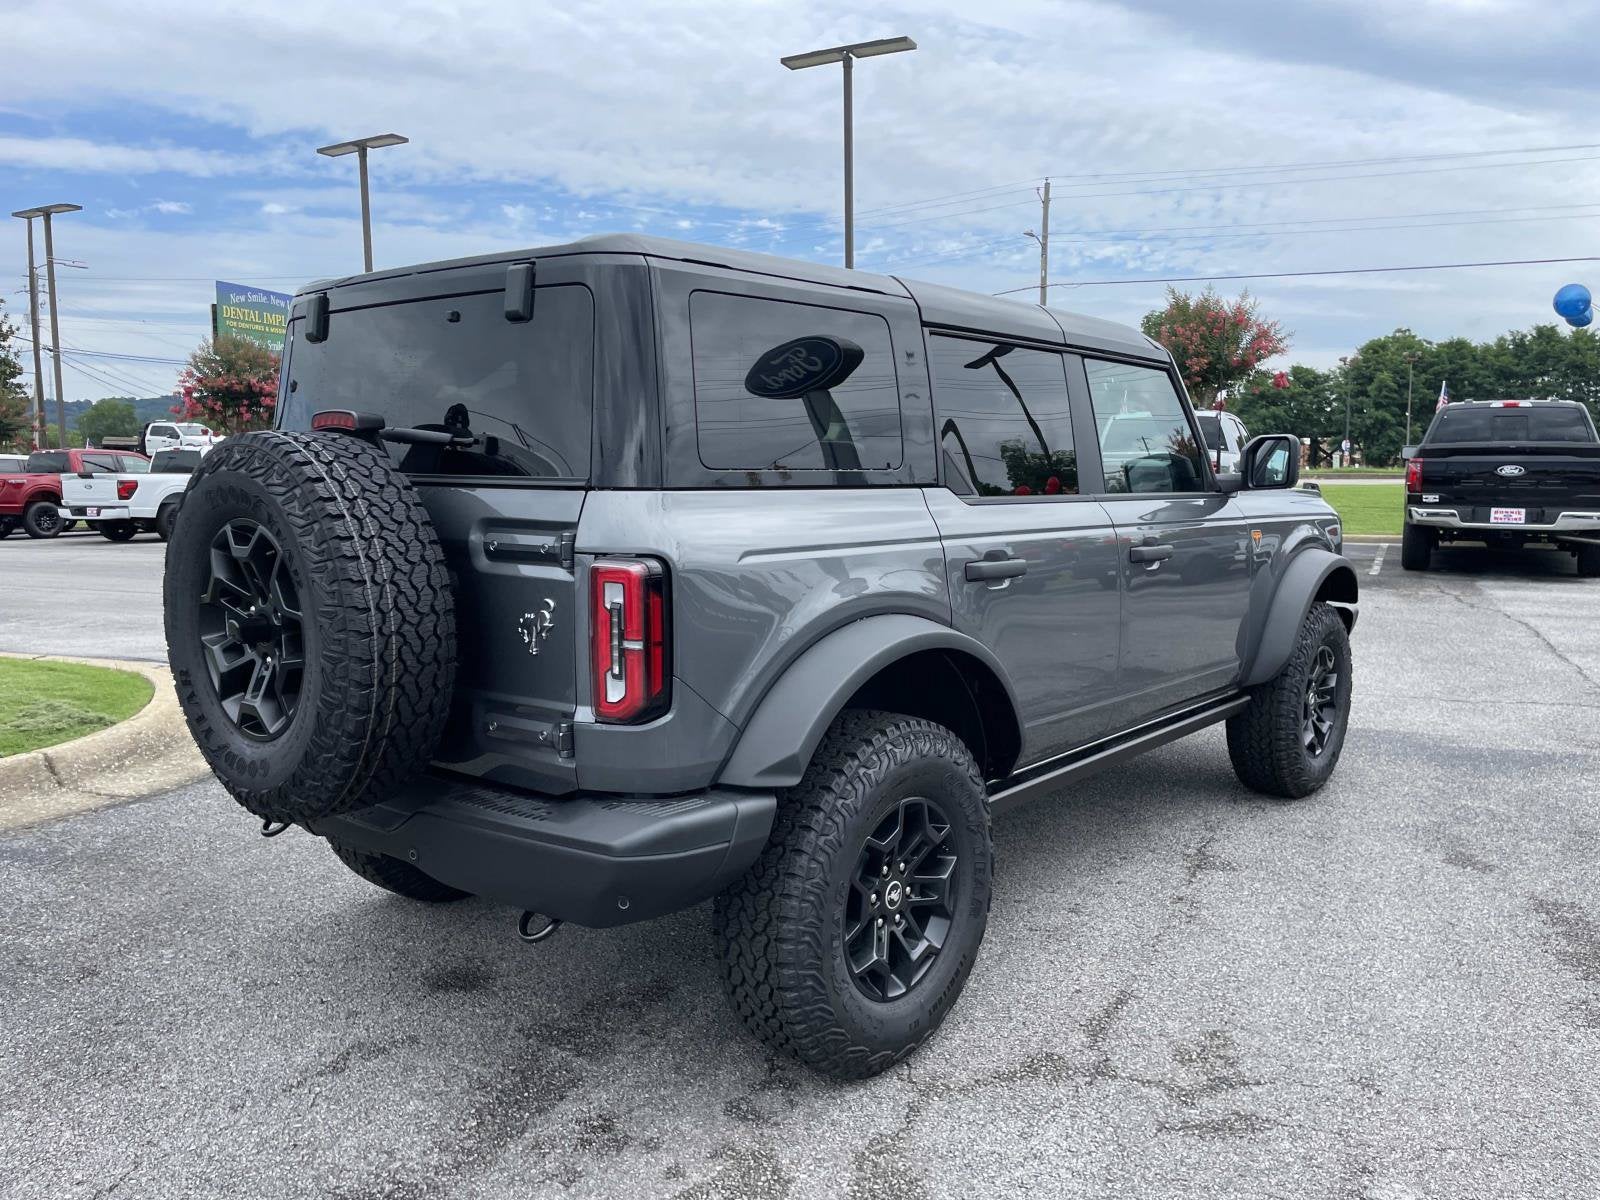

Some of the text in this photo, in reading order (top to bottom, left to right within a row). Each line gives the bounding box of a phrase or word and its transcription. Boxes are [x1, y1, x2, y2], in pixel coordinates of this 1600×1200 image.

[230, 292, 246, 304] New
[270, 294, 285, 308] New
[222, 305, 261, 323] DENTAL
[238, 321, 264, 331] DENTURES
